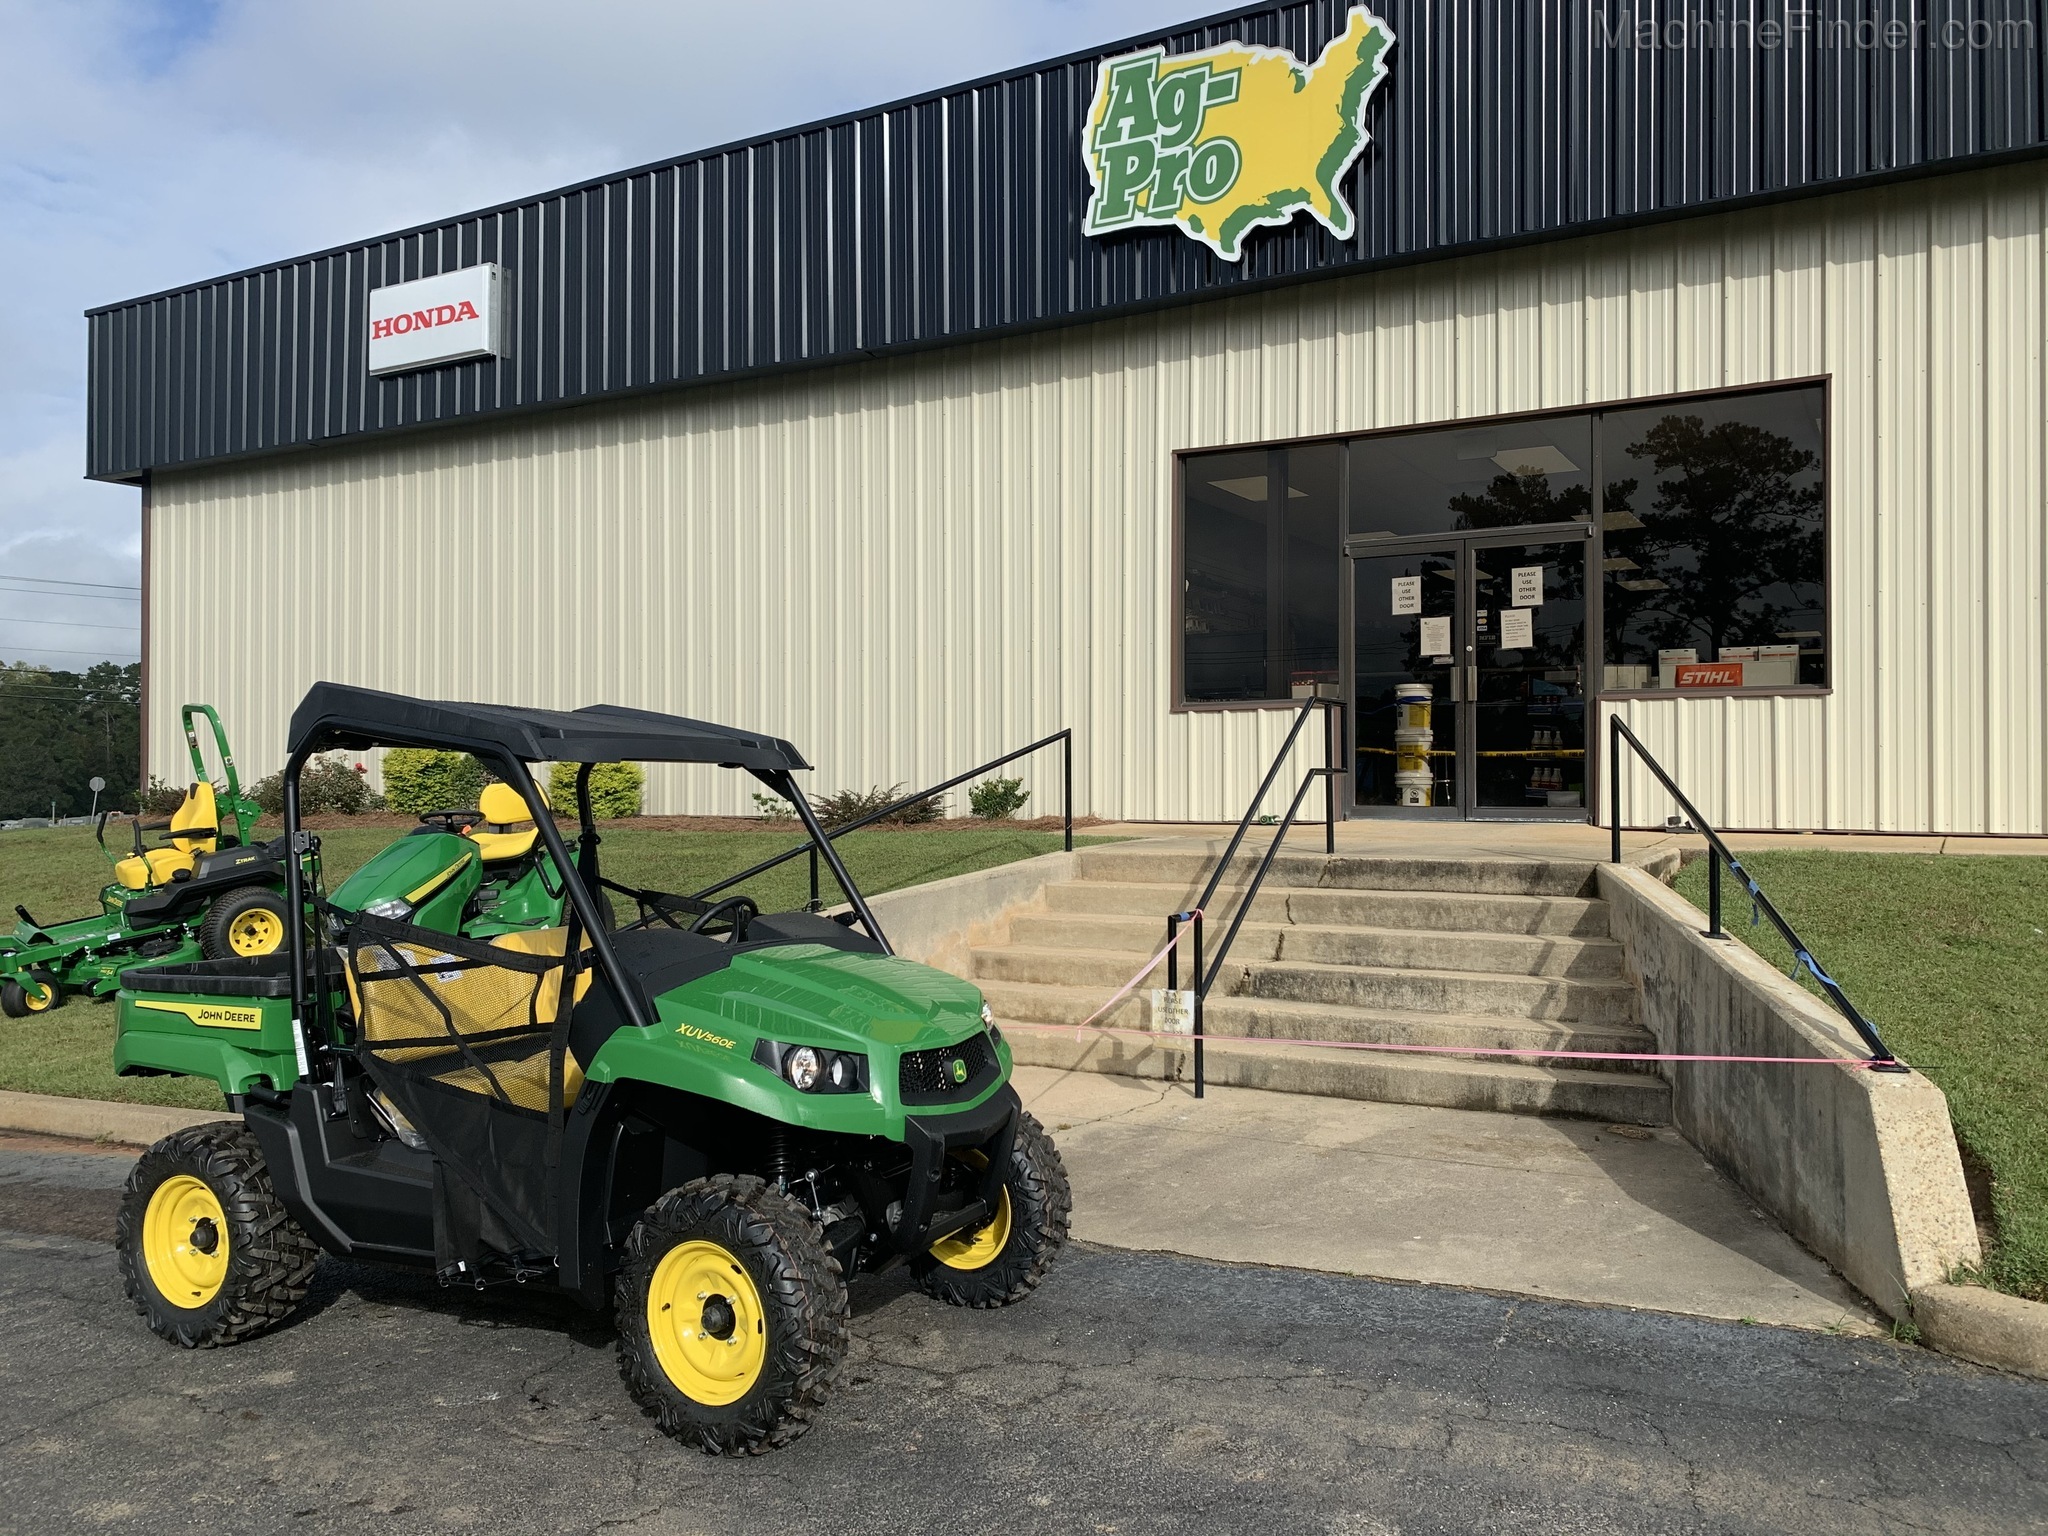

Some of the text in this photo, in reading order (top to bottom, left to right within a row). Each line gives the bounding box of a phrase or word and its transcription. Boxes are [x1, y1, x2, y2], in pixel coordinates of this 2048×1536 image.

[1095, 55, 1240, 150] Ag-
[1091, 139, 1240, 222] Pro
[372, 300, 479, 340] HONDA
[1680, 671, 1736, 684] STIHL
[198, 1009, 255, 1023] JOHN DEERE
[1169, 1007, 1189, 1015] OTHER
[675, 1023, 736, 1049] XUV560E
